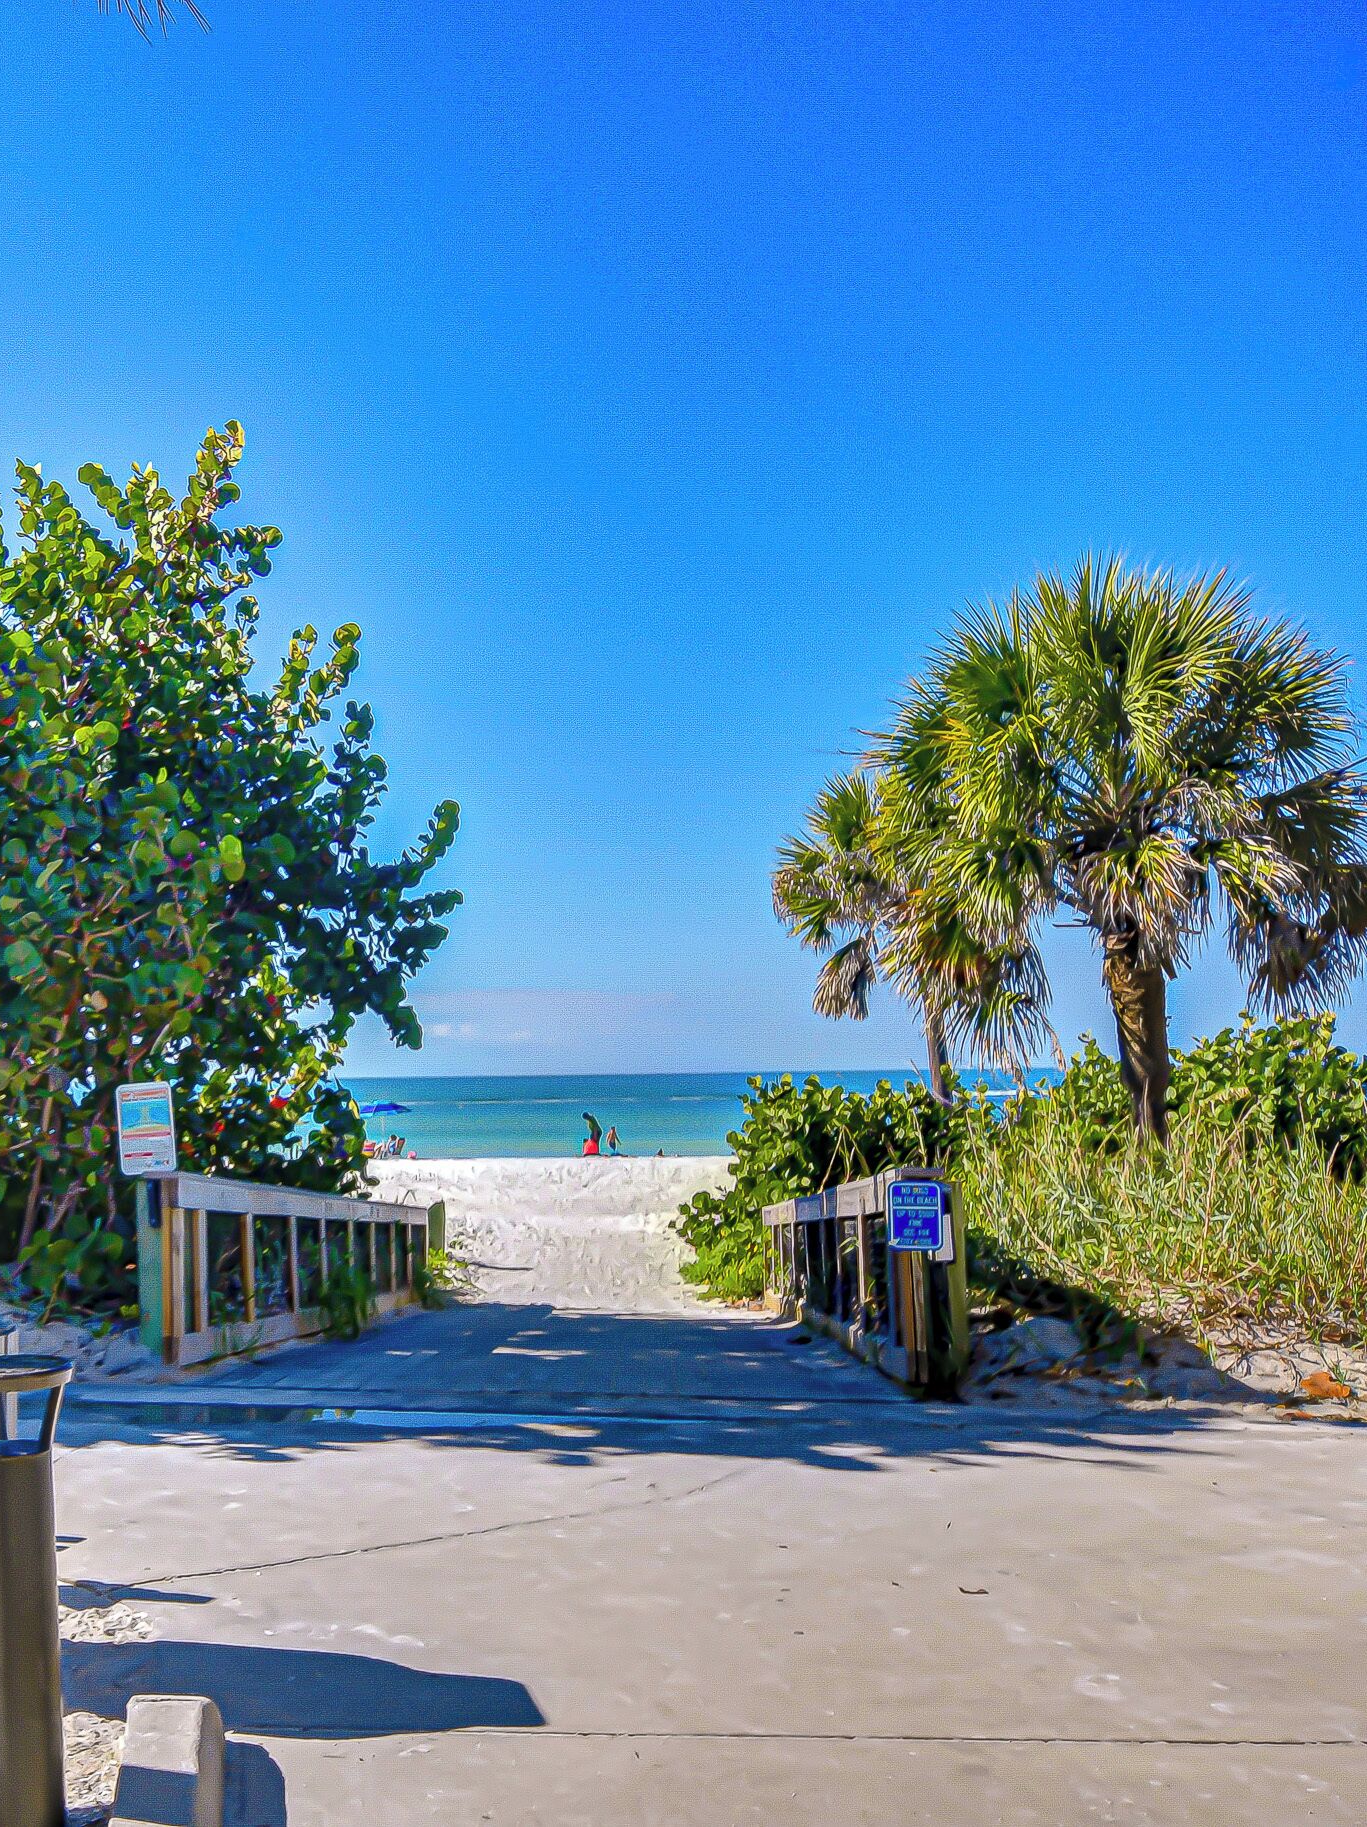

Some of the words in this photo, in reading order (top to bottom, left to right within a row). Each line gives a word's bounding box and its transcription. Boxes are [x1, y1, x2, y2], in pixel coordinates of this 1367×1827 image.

[893, 1196, 902, 1204] ON
[904, 1196, 914, 1204] THE
[916, 1196, 938, 1204] BEACH
